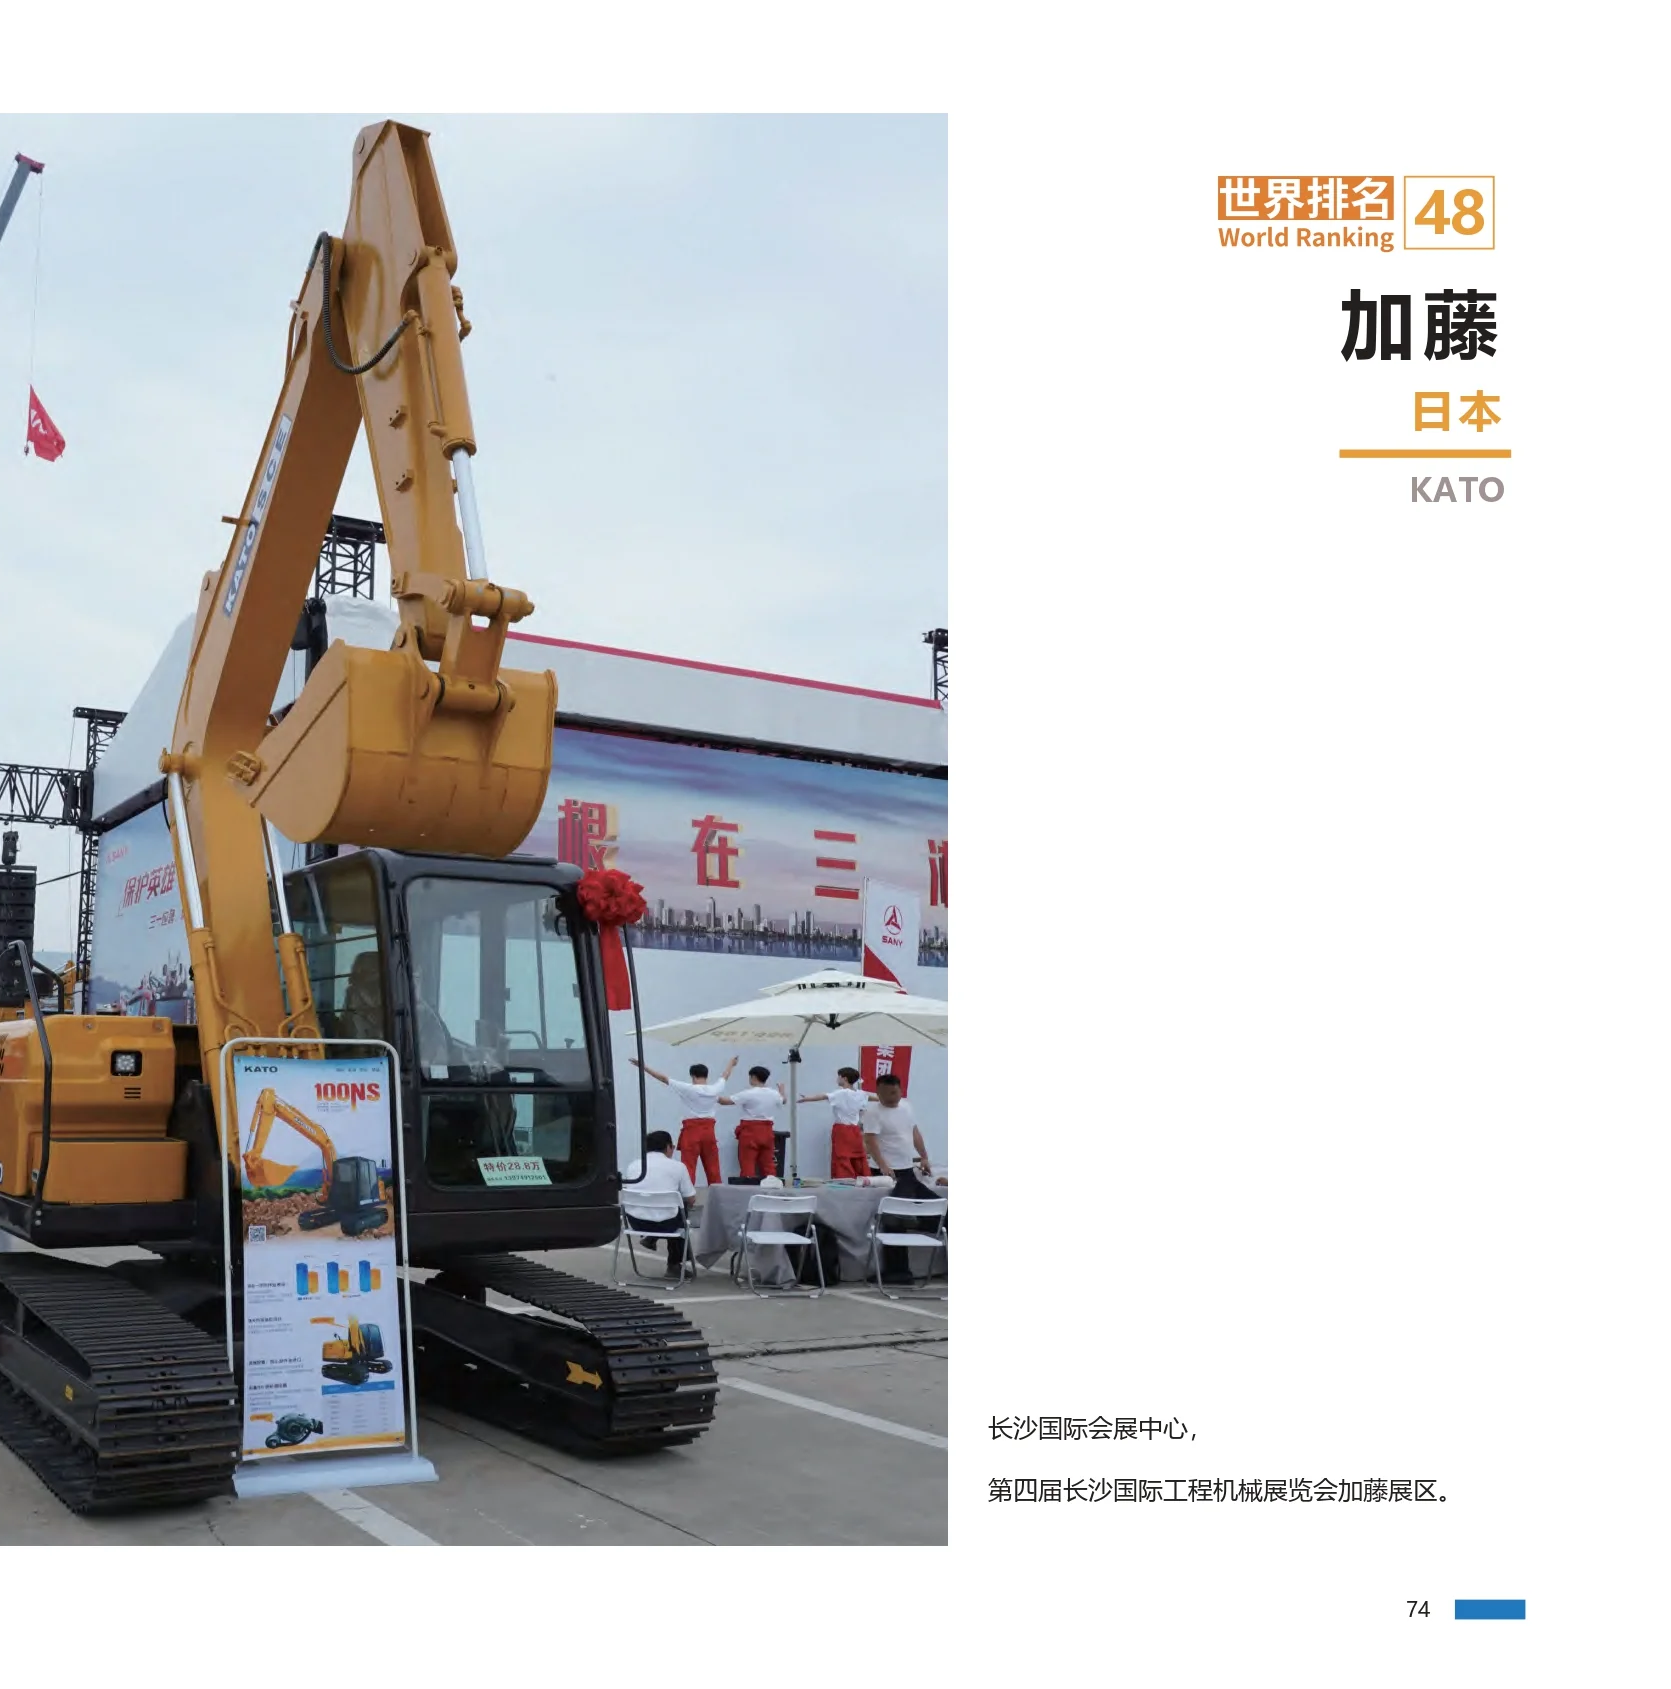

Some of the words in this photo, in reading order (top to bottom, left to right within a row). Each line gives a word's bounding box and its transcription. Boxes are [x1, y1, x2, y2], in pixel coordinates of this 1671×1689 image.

[224, 524, 257, 617] KATO
[882, 935, 903, 948] SANY
[244, 1065, 278, 1073] KATO
[314, 1083, 381, 1112] 100NS
